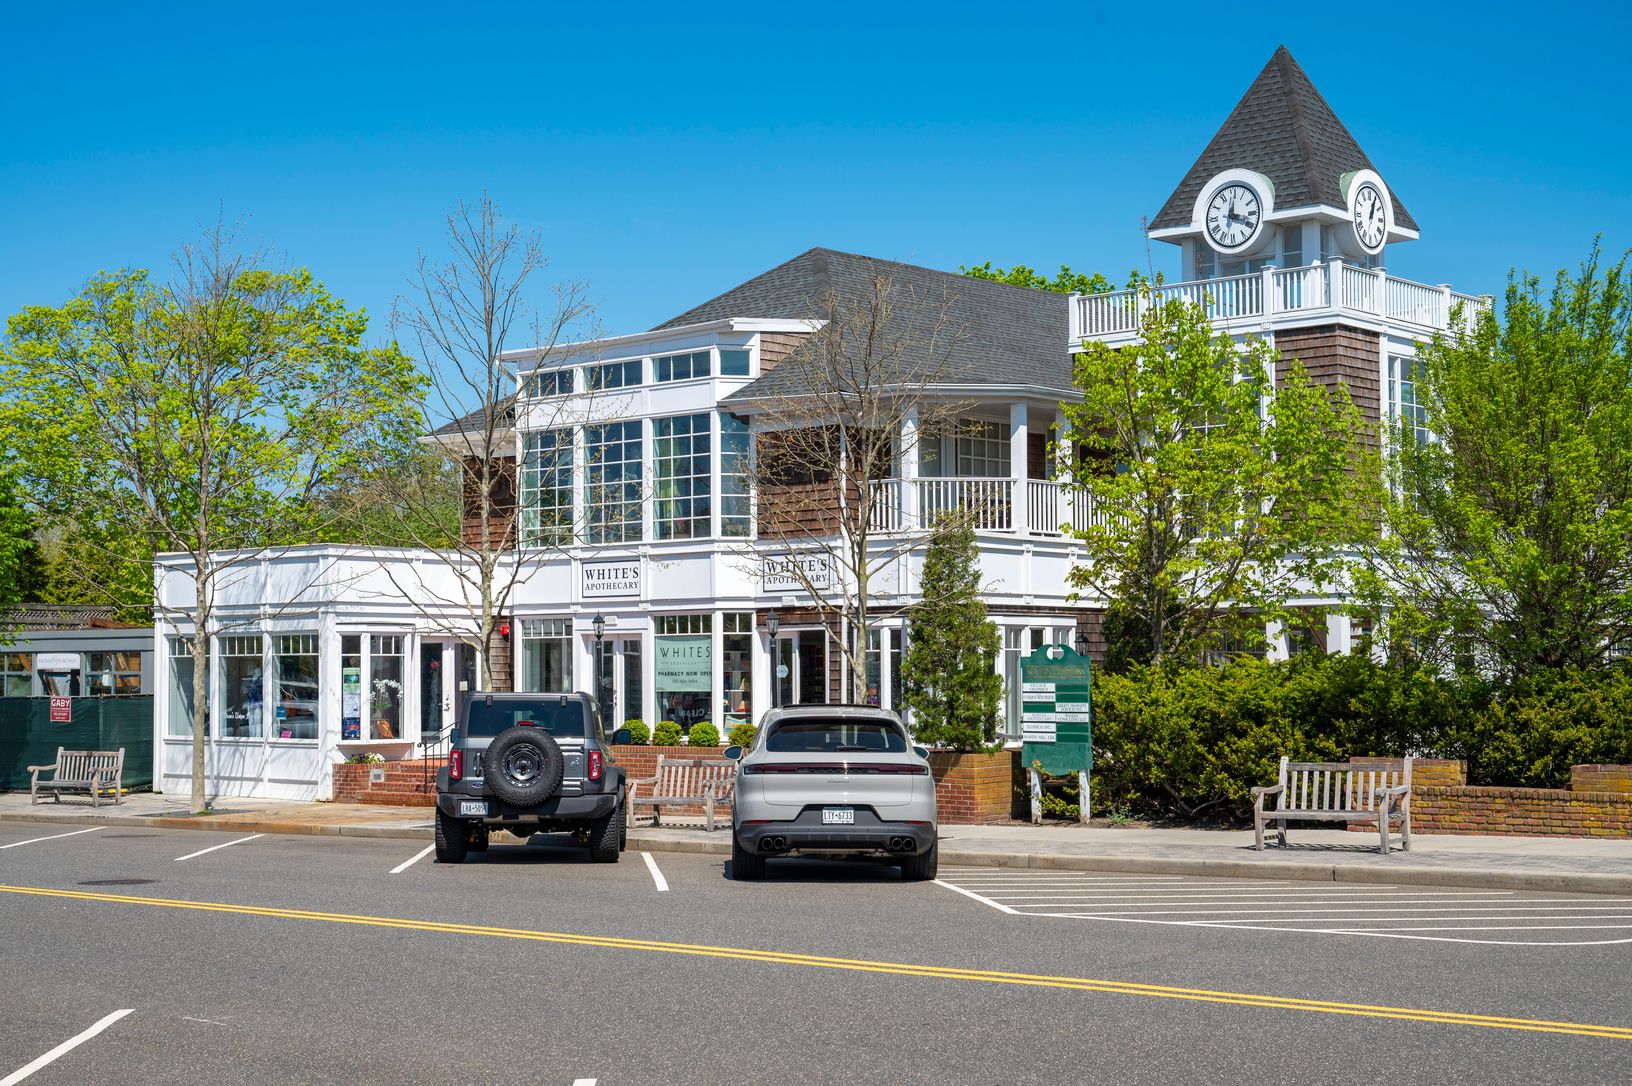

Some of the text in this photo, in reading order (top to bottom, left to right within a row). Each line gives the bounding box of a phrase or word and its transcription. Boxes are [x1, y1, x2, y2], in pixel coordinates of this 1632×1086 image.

[585, 567, 639, 580] WHITE'S
[766, 574, 827, 585] APOTHARY
[585, 581, 639, 591] APOTHECARY
[660, 646, 711, 658] WHITES
[51, 698, 70, 707] GABY
